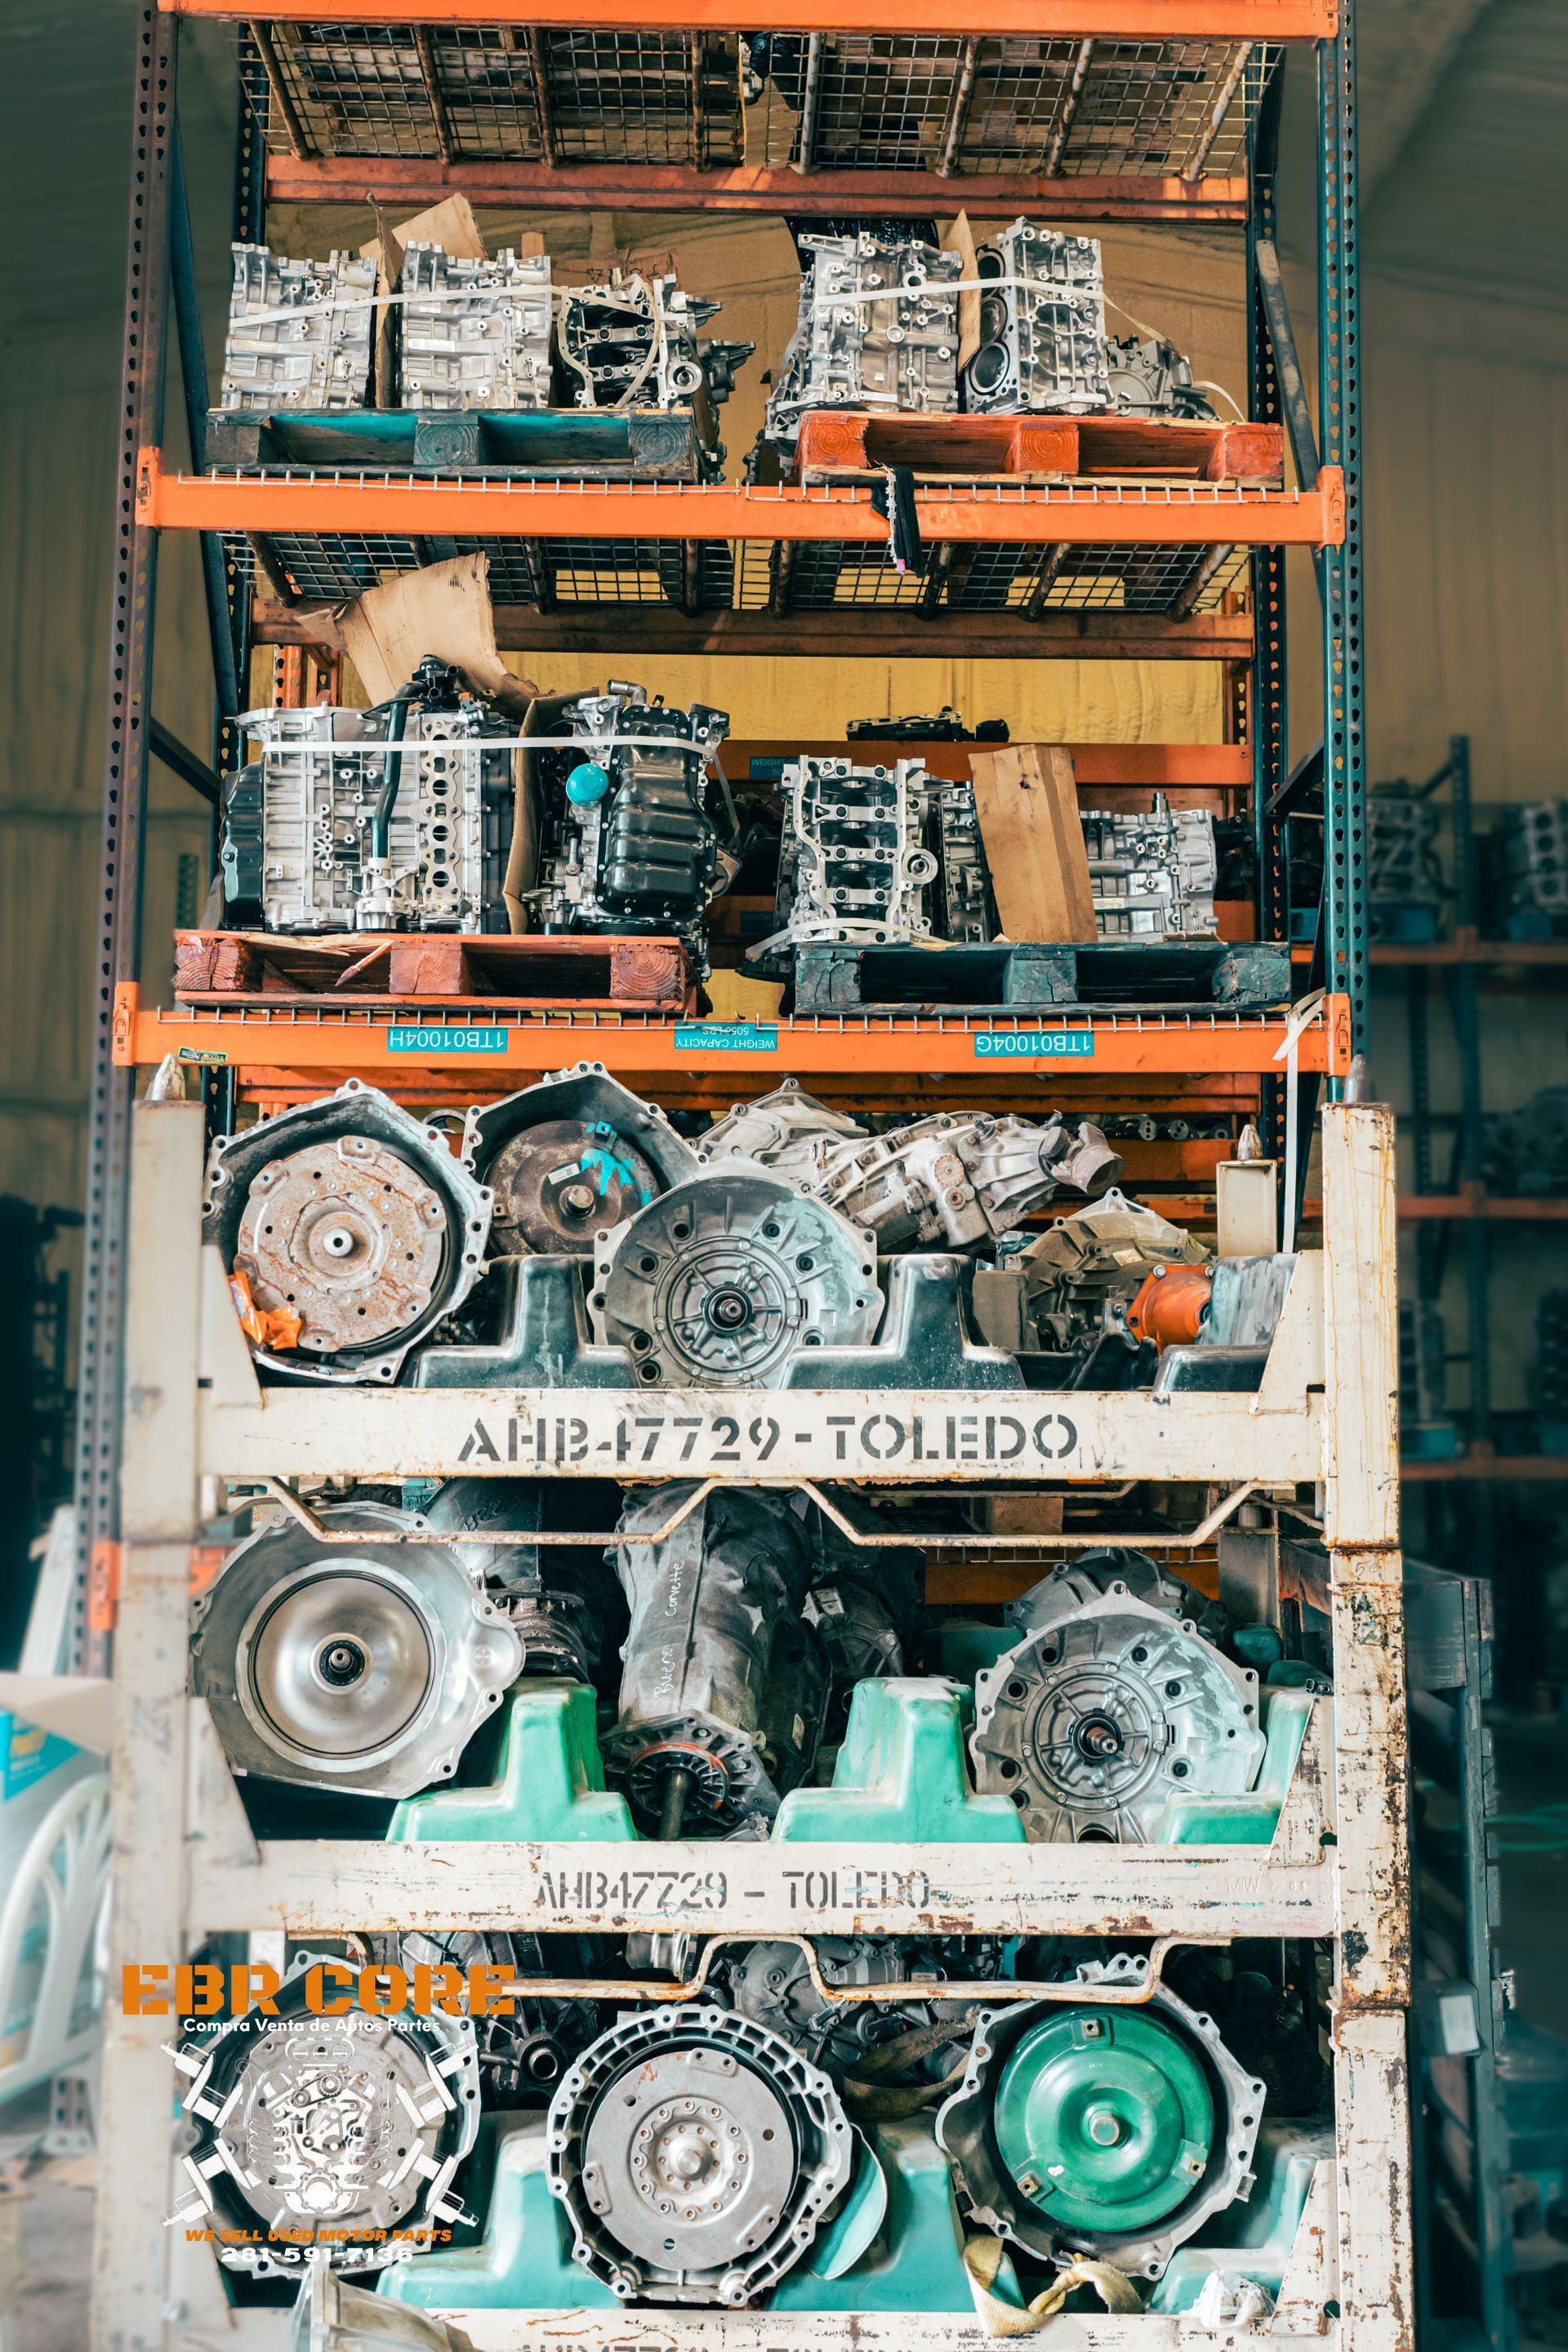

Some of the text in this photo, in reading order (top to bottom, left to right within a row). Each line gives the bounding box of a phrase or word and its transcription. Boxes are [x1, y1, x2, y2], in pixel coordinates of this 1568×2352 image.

[390, 1031, 504, 1049] 1TB01004H
[675, 1038, 775, 1049] WEIGHT CAPACITY
[976, 1035, 1091, 1053] 1TB01004G
[664, 1560, 685, 1617] Corvette
[537, 1871, 728, 1909] AHB47729
[782, 1870, 929, 1909] TOLEDO
